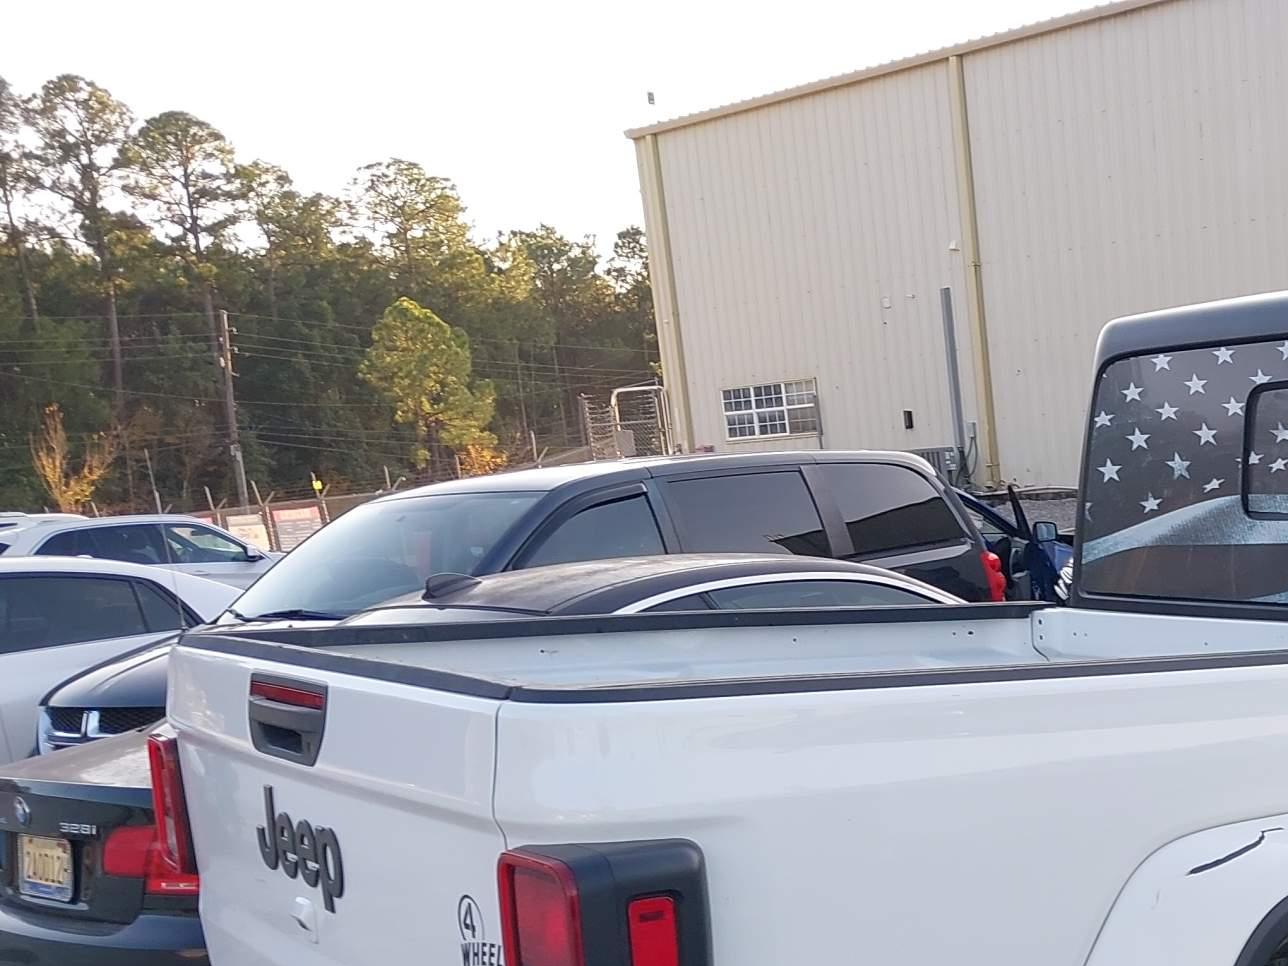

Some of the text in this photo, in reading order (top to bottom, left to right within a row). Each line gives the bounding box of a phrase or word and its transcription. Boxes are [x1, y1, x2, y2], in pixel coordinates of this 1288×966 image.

[58, 821, 97, 835] 328i
[256, 784, 345, 914] Jeep
[463, 902, 476, 939] 4
